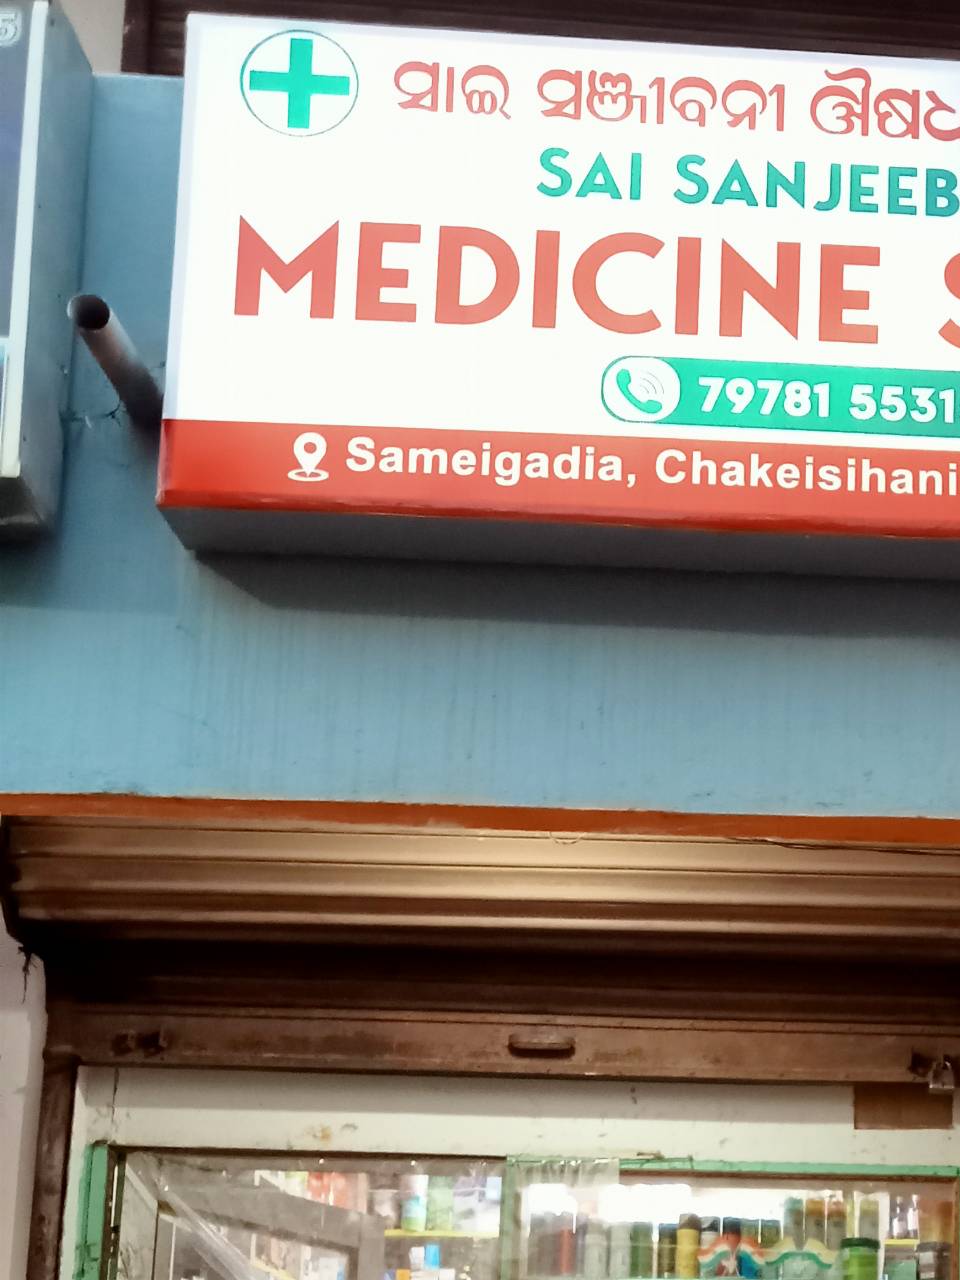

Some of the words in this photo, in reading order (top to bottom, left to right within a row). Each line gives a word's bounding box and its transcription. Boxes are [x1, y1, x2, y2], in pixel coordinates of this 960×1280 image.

[393, 61, 511, 119] ସାଇ
[537, 69, 784, 132] ସଞ୍ଜୀବନୀ
[537, 147, 641, 200] SAI
[234, 215, 880, 344] MEDICINE
[698, 376, 830, 418] 79781
[345, 436, 637, 488] Sameigadia,
